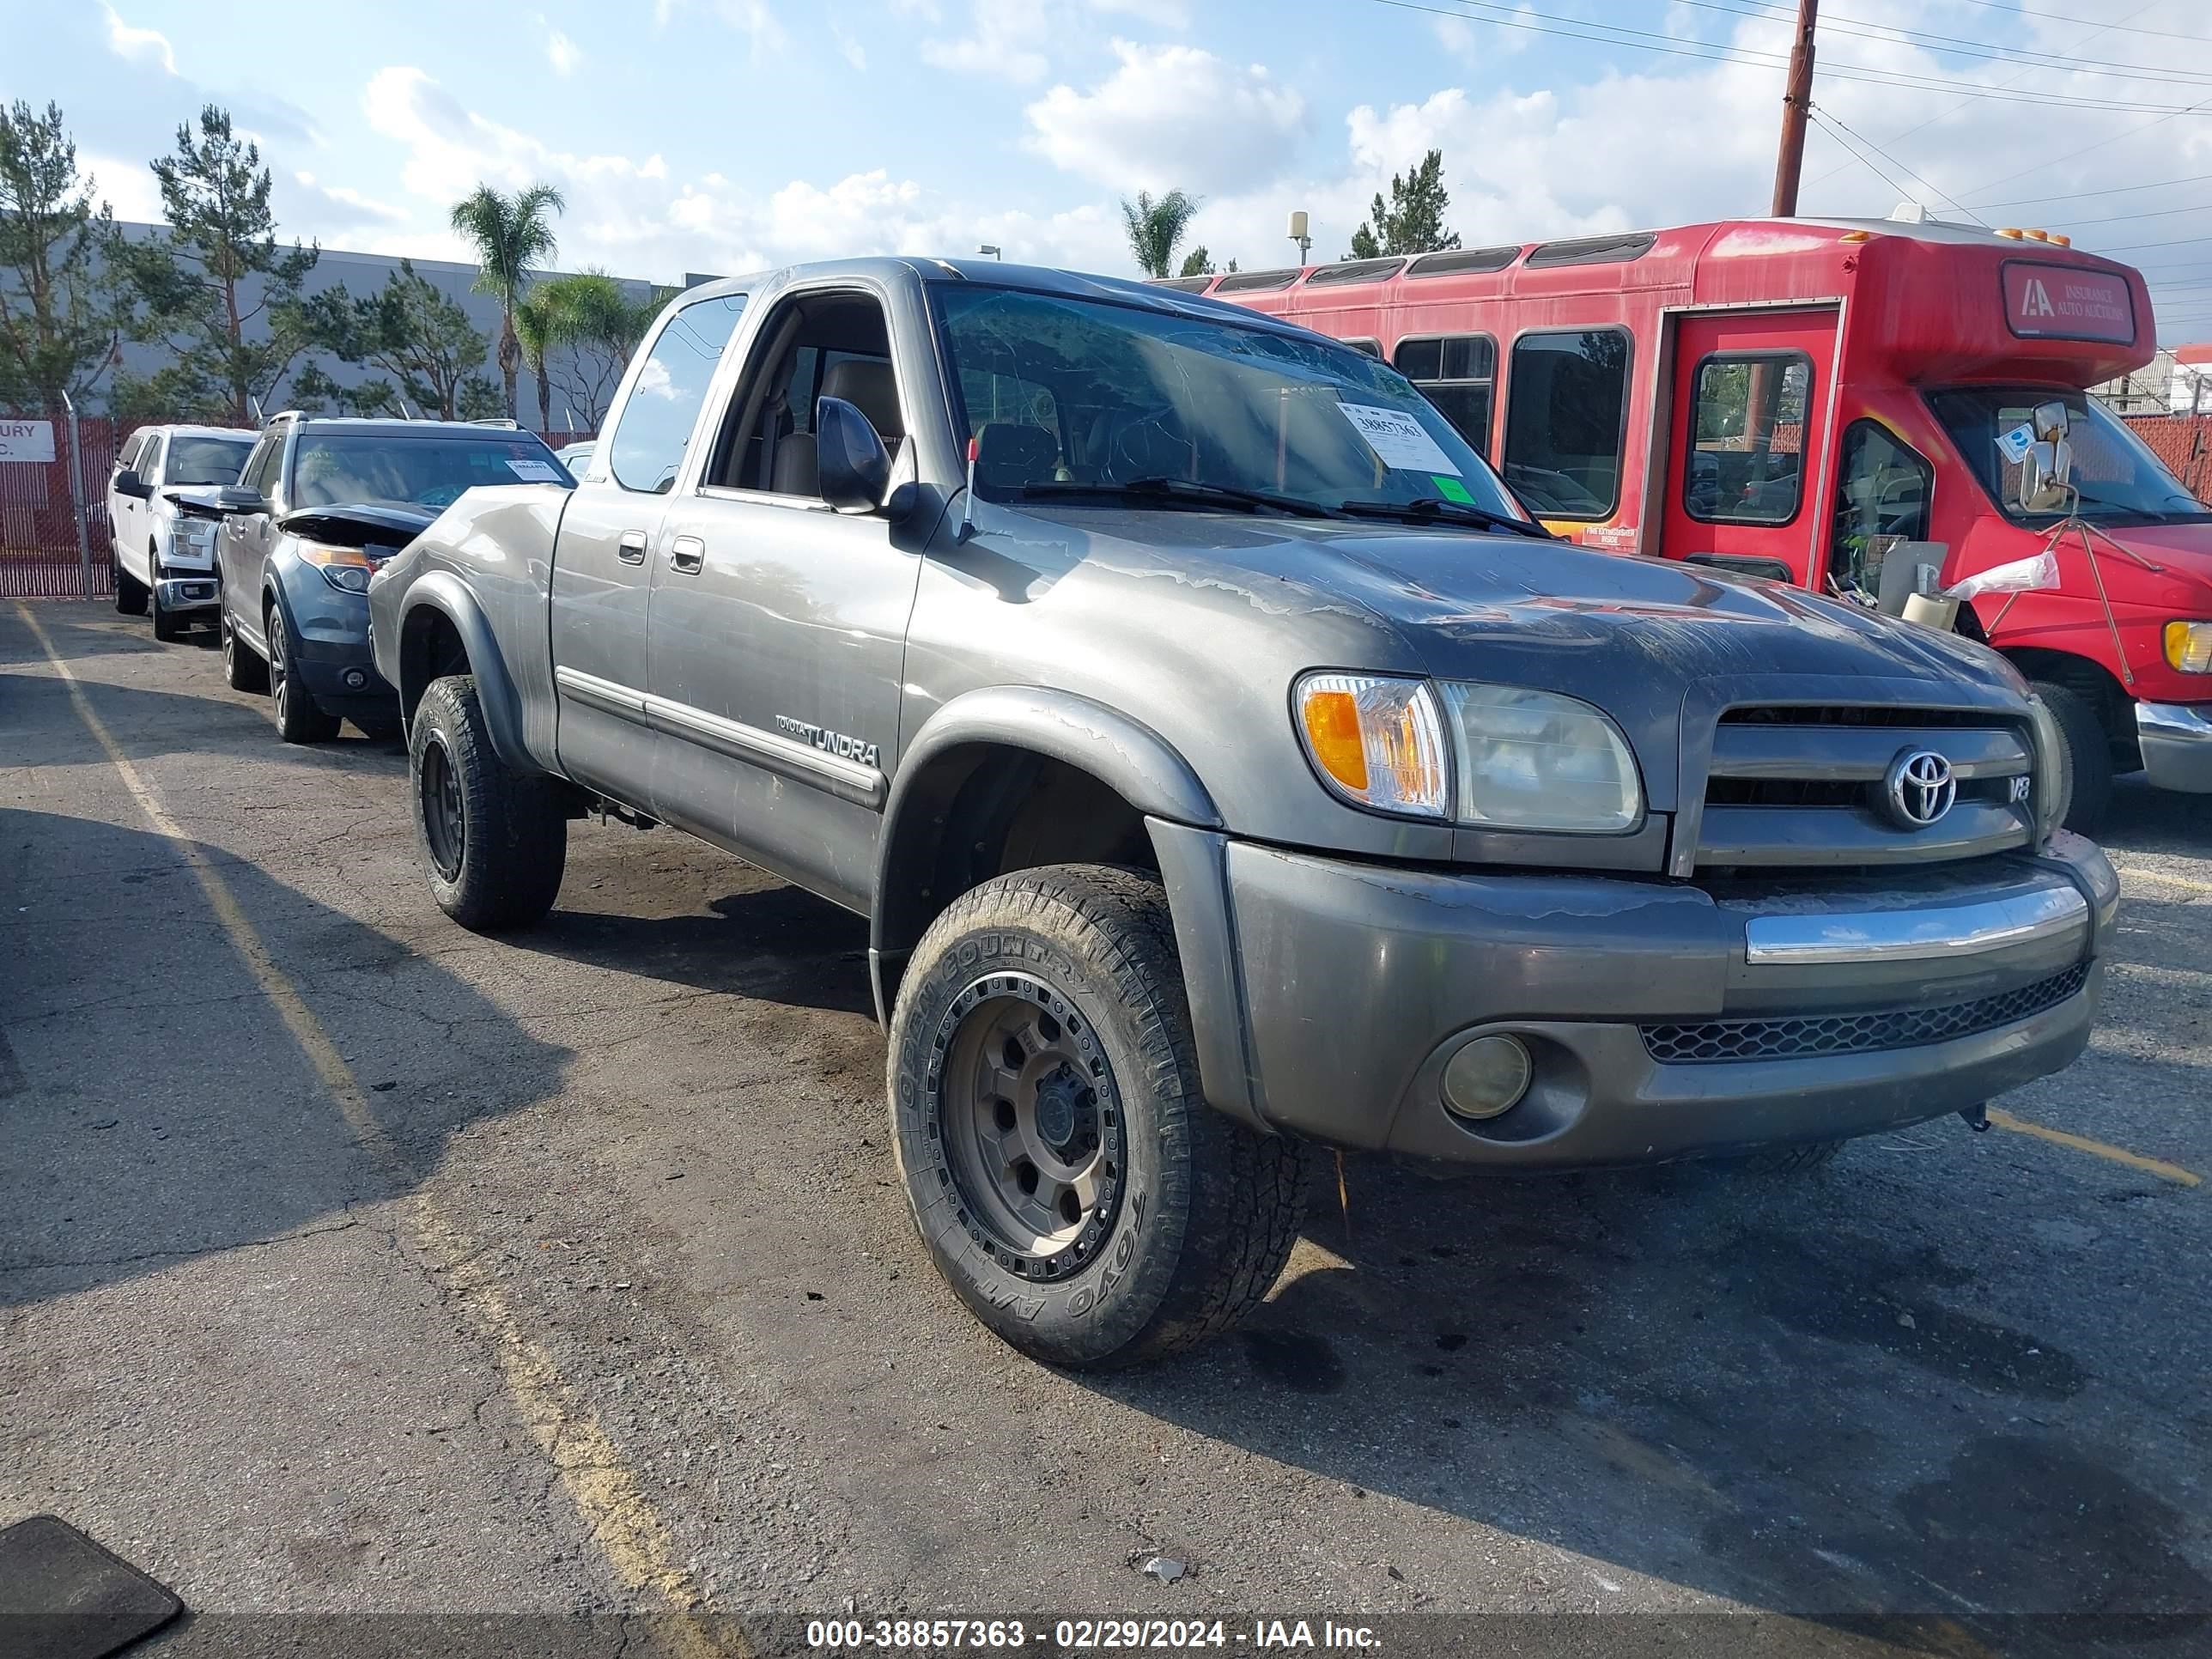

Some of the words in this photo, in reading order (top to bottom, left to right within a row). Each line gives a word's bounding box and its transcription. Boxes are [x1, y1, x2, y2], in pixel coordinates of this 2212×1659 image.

[2065, 284, 2113, 303] INSURANCE
[2057, 301, 2082, 316] AUTO
[2084, 303, 2124, 321] AUCTIONS
[1357, 416, 1423, 438] 38857363
[1587, 527, 1597, 536] FIRE
[1598, 527, 1635, 537] EXTINGUISHER
[775, 714, 805, 736] TOYOTA
[804, 723, 882, 769] TUNDRA
[2008, 775, 2031, 803] V8
[899, 980, 938, 1109] OPEN
[943, 933, 1095, 994] COUNTRY
[1066, 1189, 1146, 1319] TOYO
